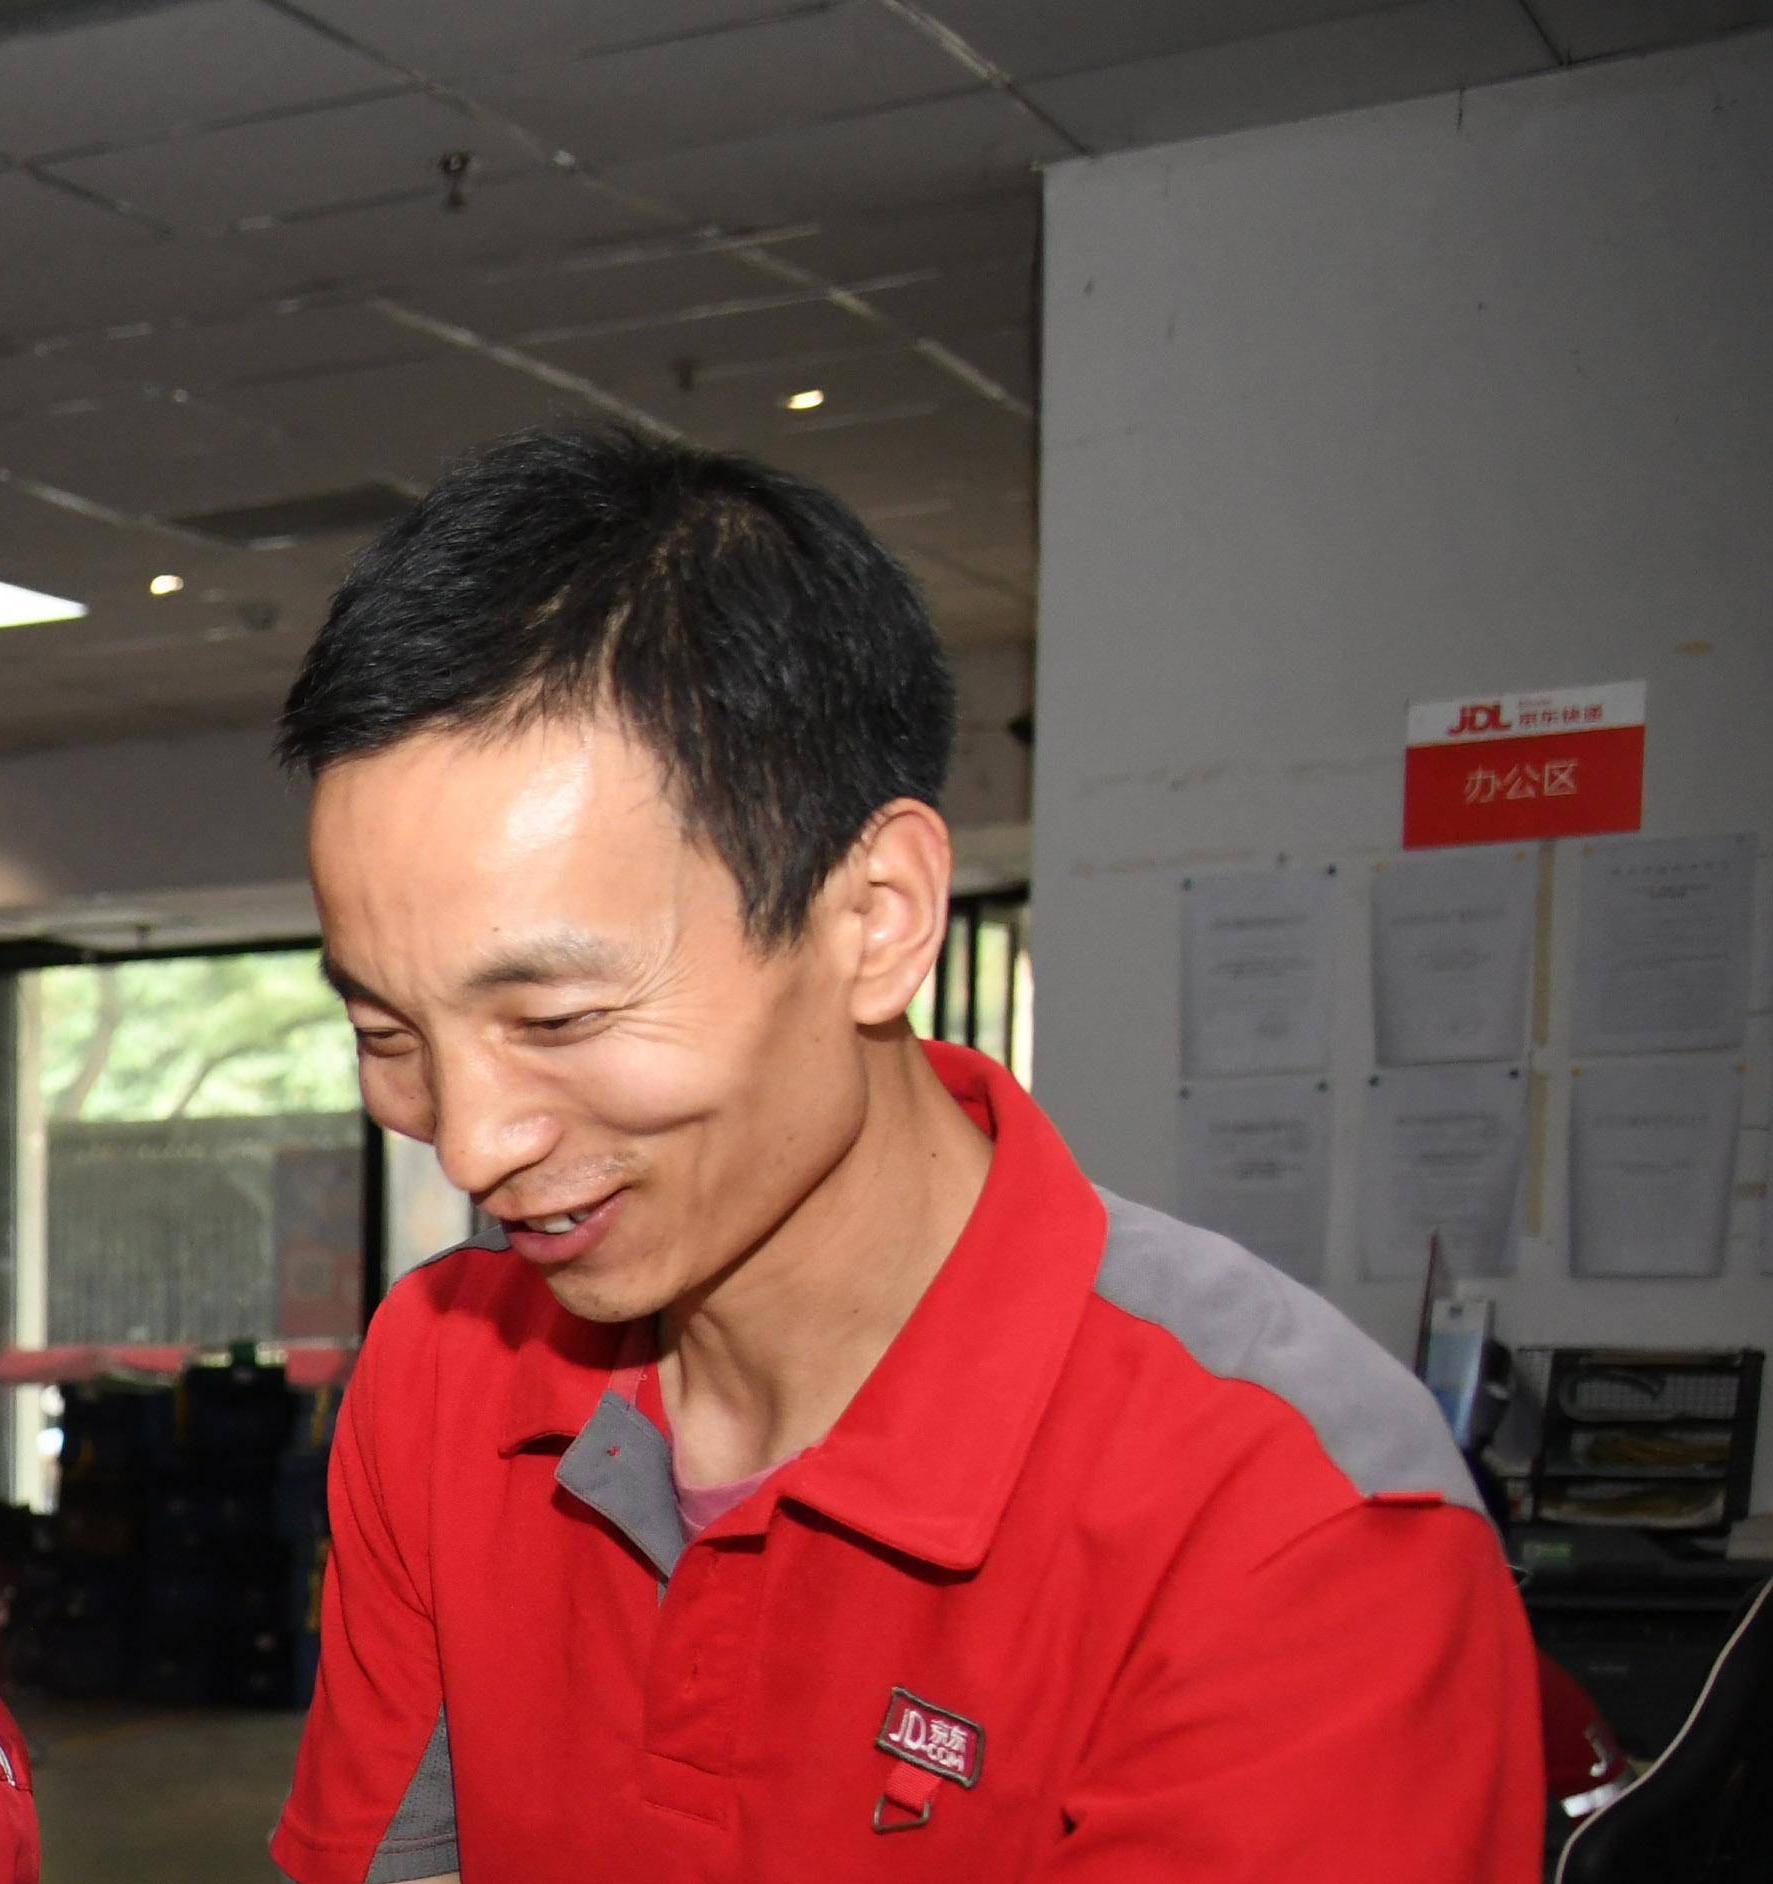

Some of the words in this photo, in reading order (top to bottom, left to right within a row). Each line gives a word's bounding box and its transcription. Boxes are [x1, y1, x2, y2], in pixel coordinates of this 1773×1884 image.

[1448, 702, 1512, 736] JDL
[1463, 758, 1580, 806] 办公区
[928, 1719, 969, 1752] 京东
